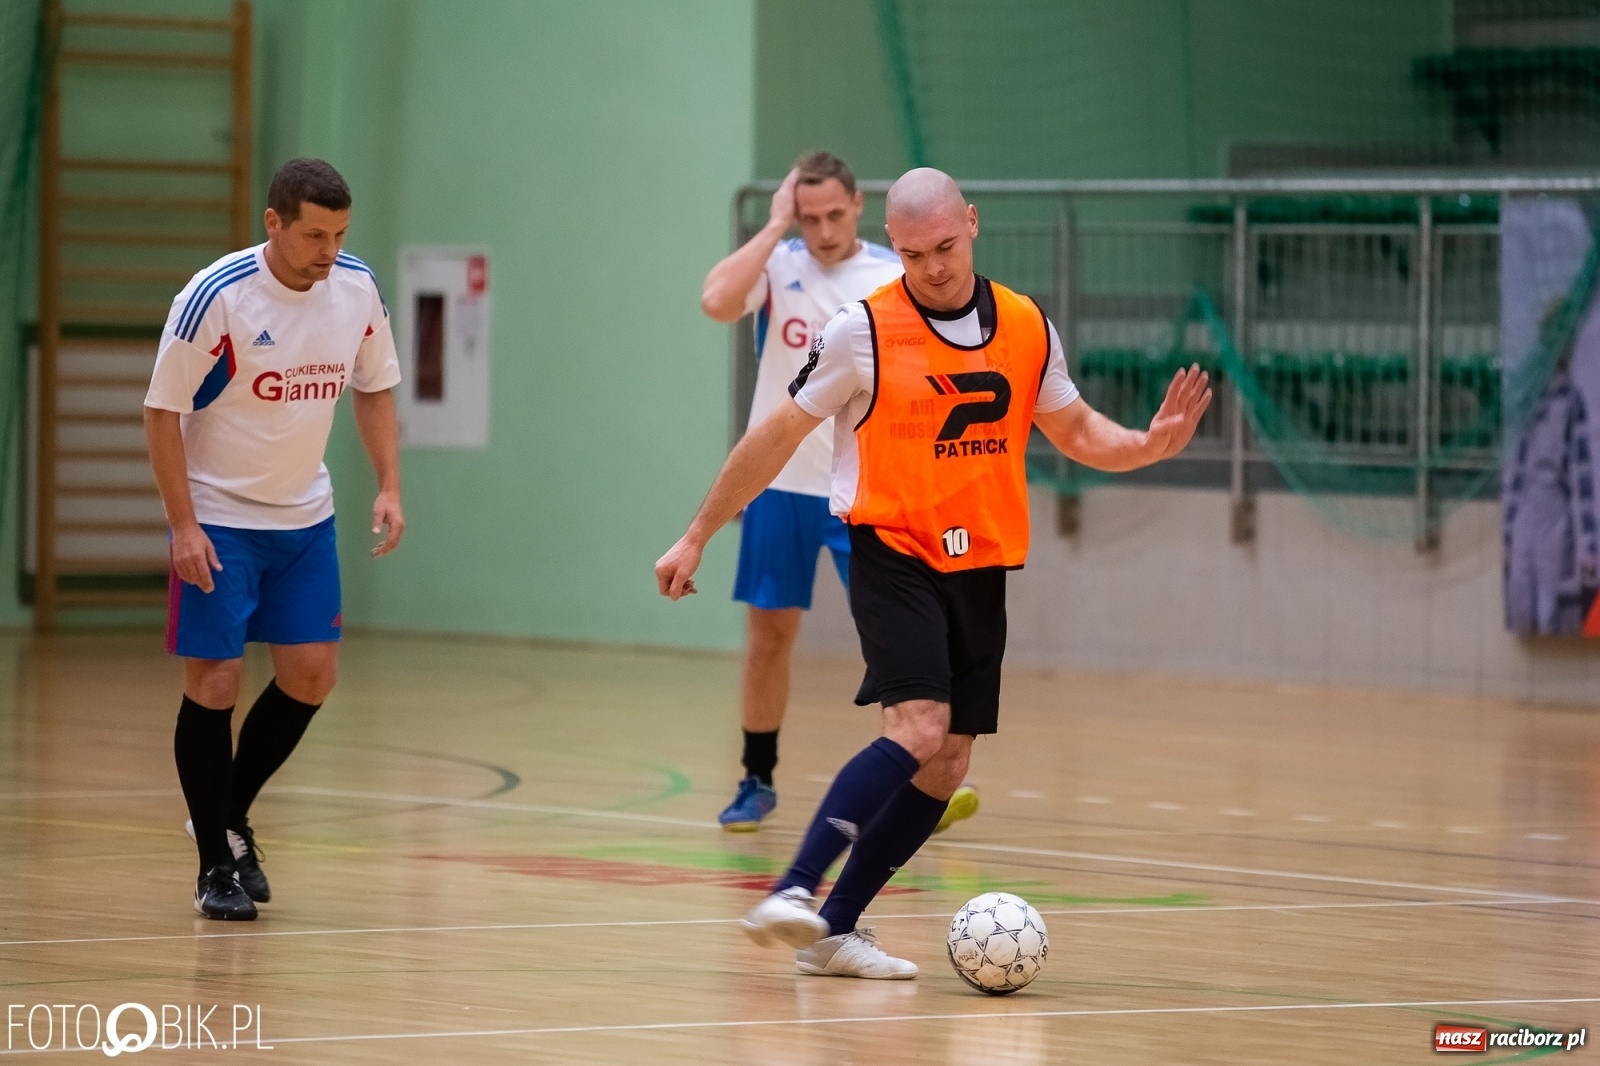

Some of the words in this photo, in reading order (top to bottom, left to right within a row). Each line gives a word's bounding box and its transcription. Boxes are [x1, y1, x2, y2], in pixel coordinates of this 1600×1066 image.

[285, 363, 345, 378] CUKIERNIA
[252, 371, 345, 403] Gianni
[934, 438, 1008, 459] PATRICK
[942, 528, 969, 556] 10
